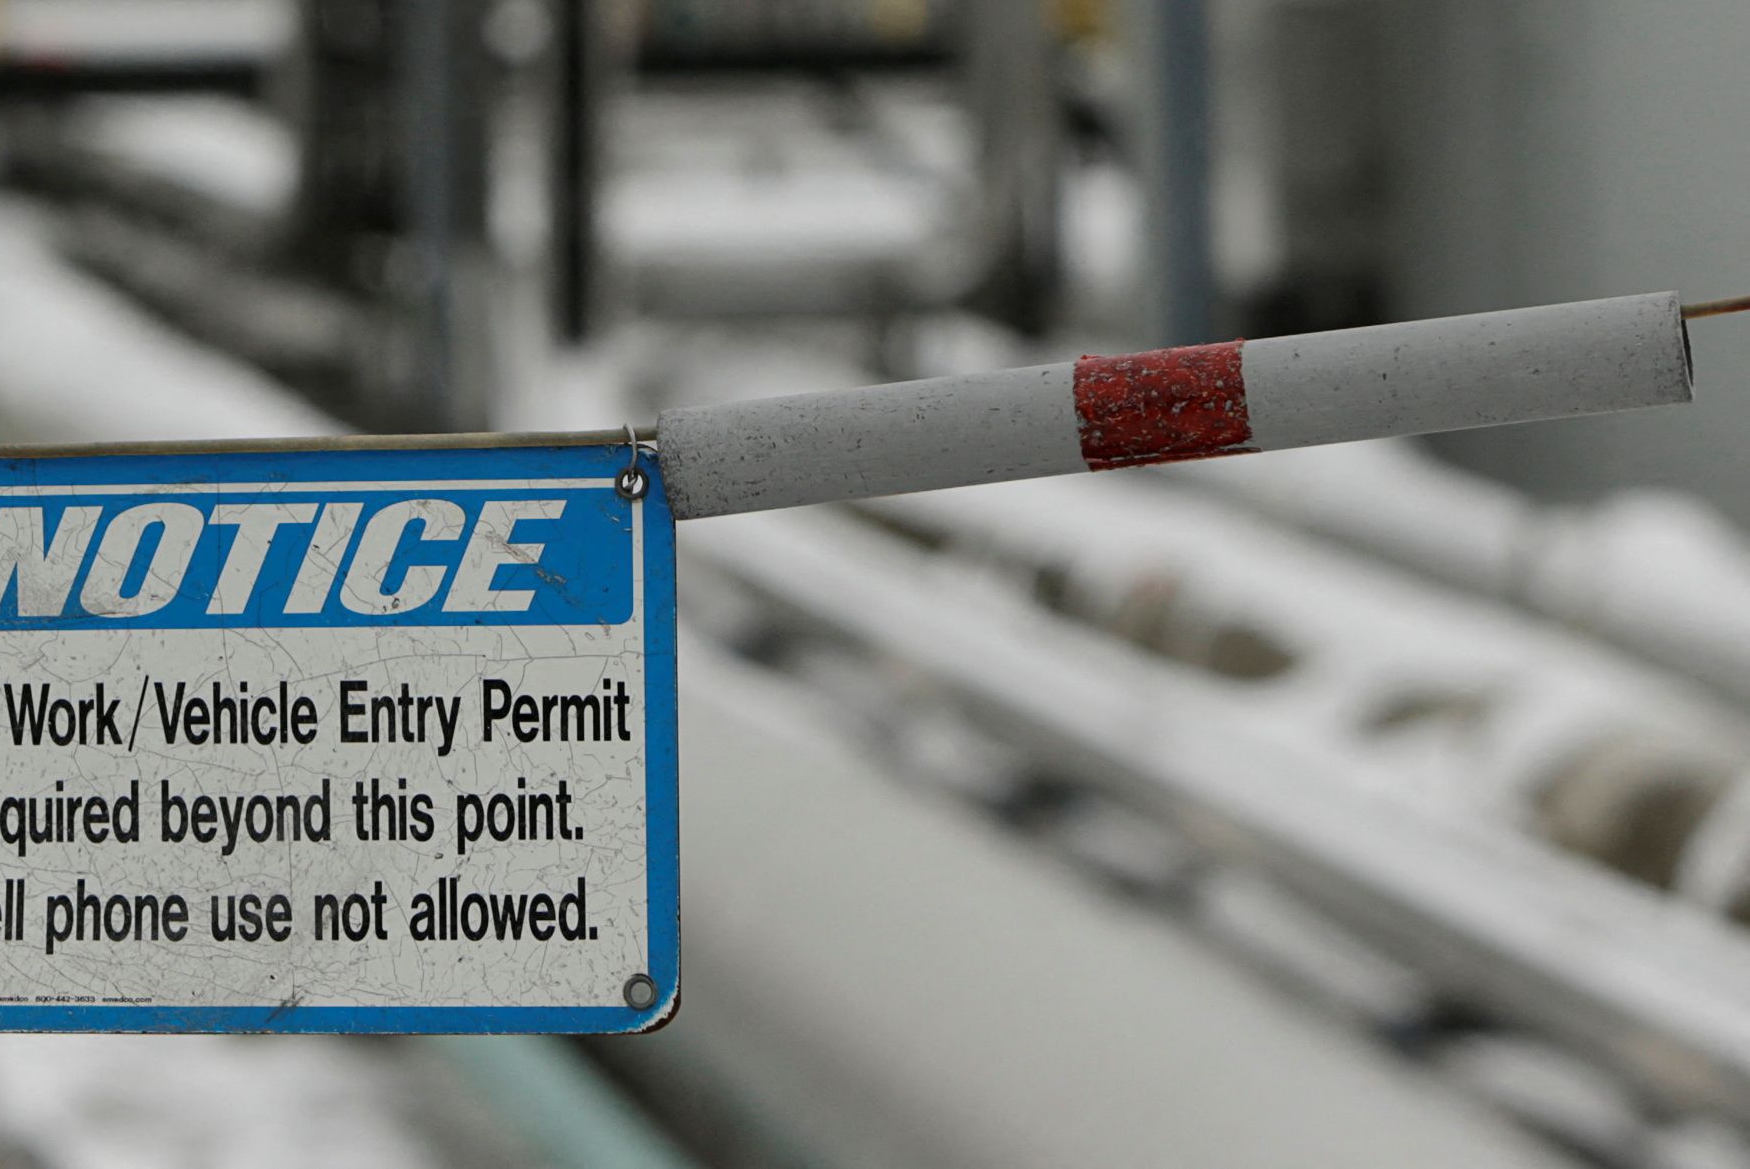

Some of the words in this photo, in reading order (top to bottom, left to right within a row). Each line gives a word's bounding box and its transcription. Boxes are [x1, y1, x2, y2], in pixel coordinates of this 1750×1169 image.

[5, 675, 318, 752] Work/Vehicle
[340, 680, 460, 755] Entry
[483, 678, 630, 744] Permit
[161, 779, 330, 856] beyond
[353, 779, 435, 841] this
[456, 778, 584, 855] point.
[46, 879, 189, 954] phone
[211, 893, 292, 942] use
[314, 881, 387, 942] not
[410, 878, 598, 942] allowed.
